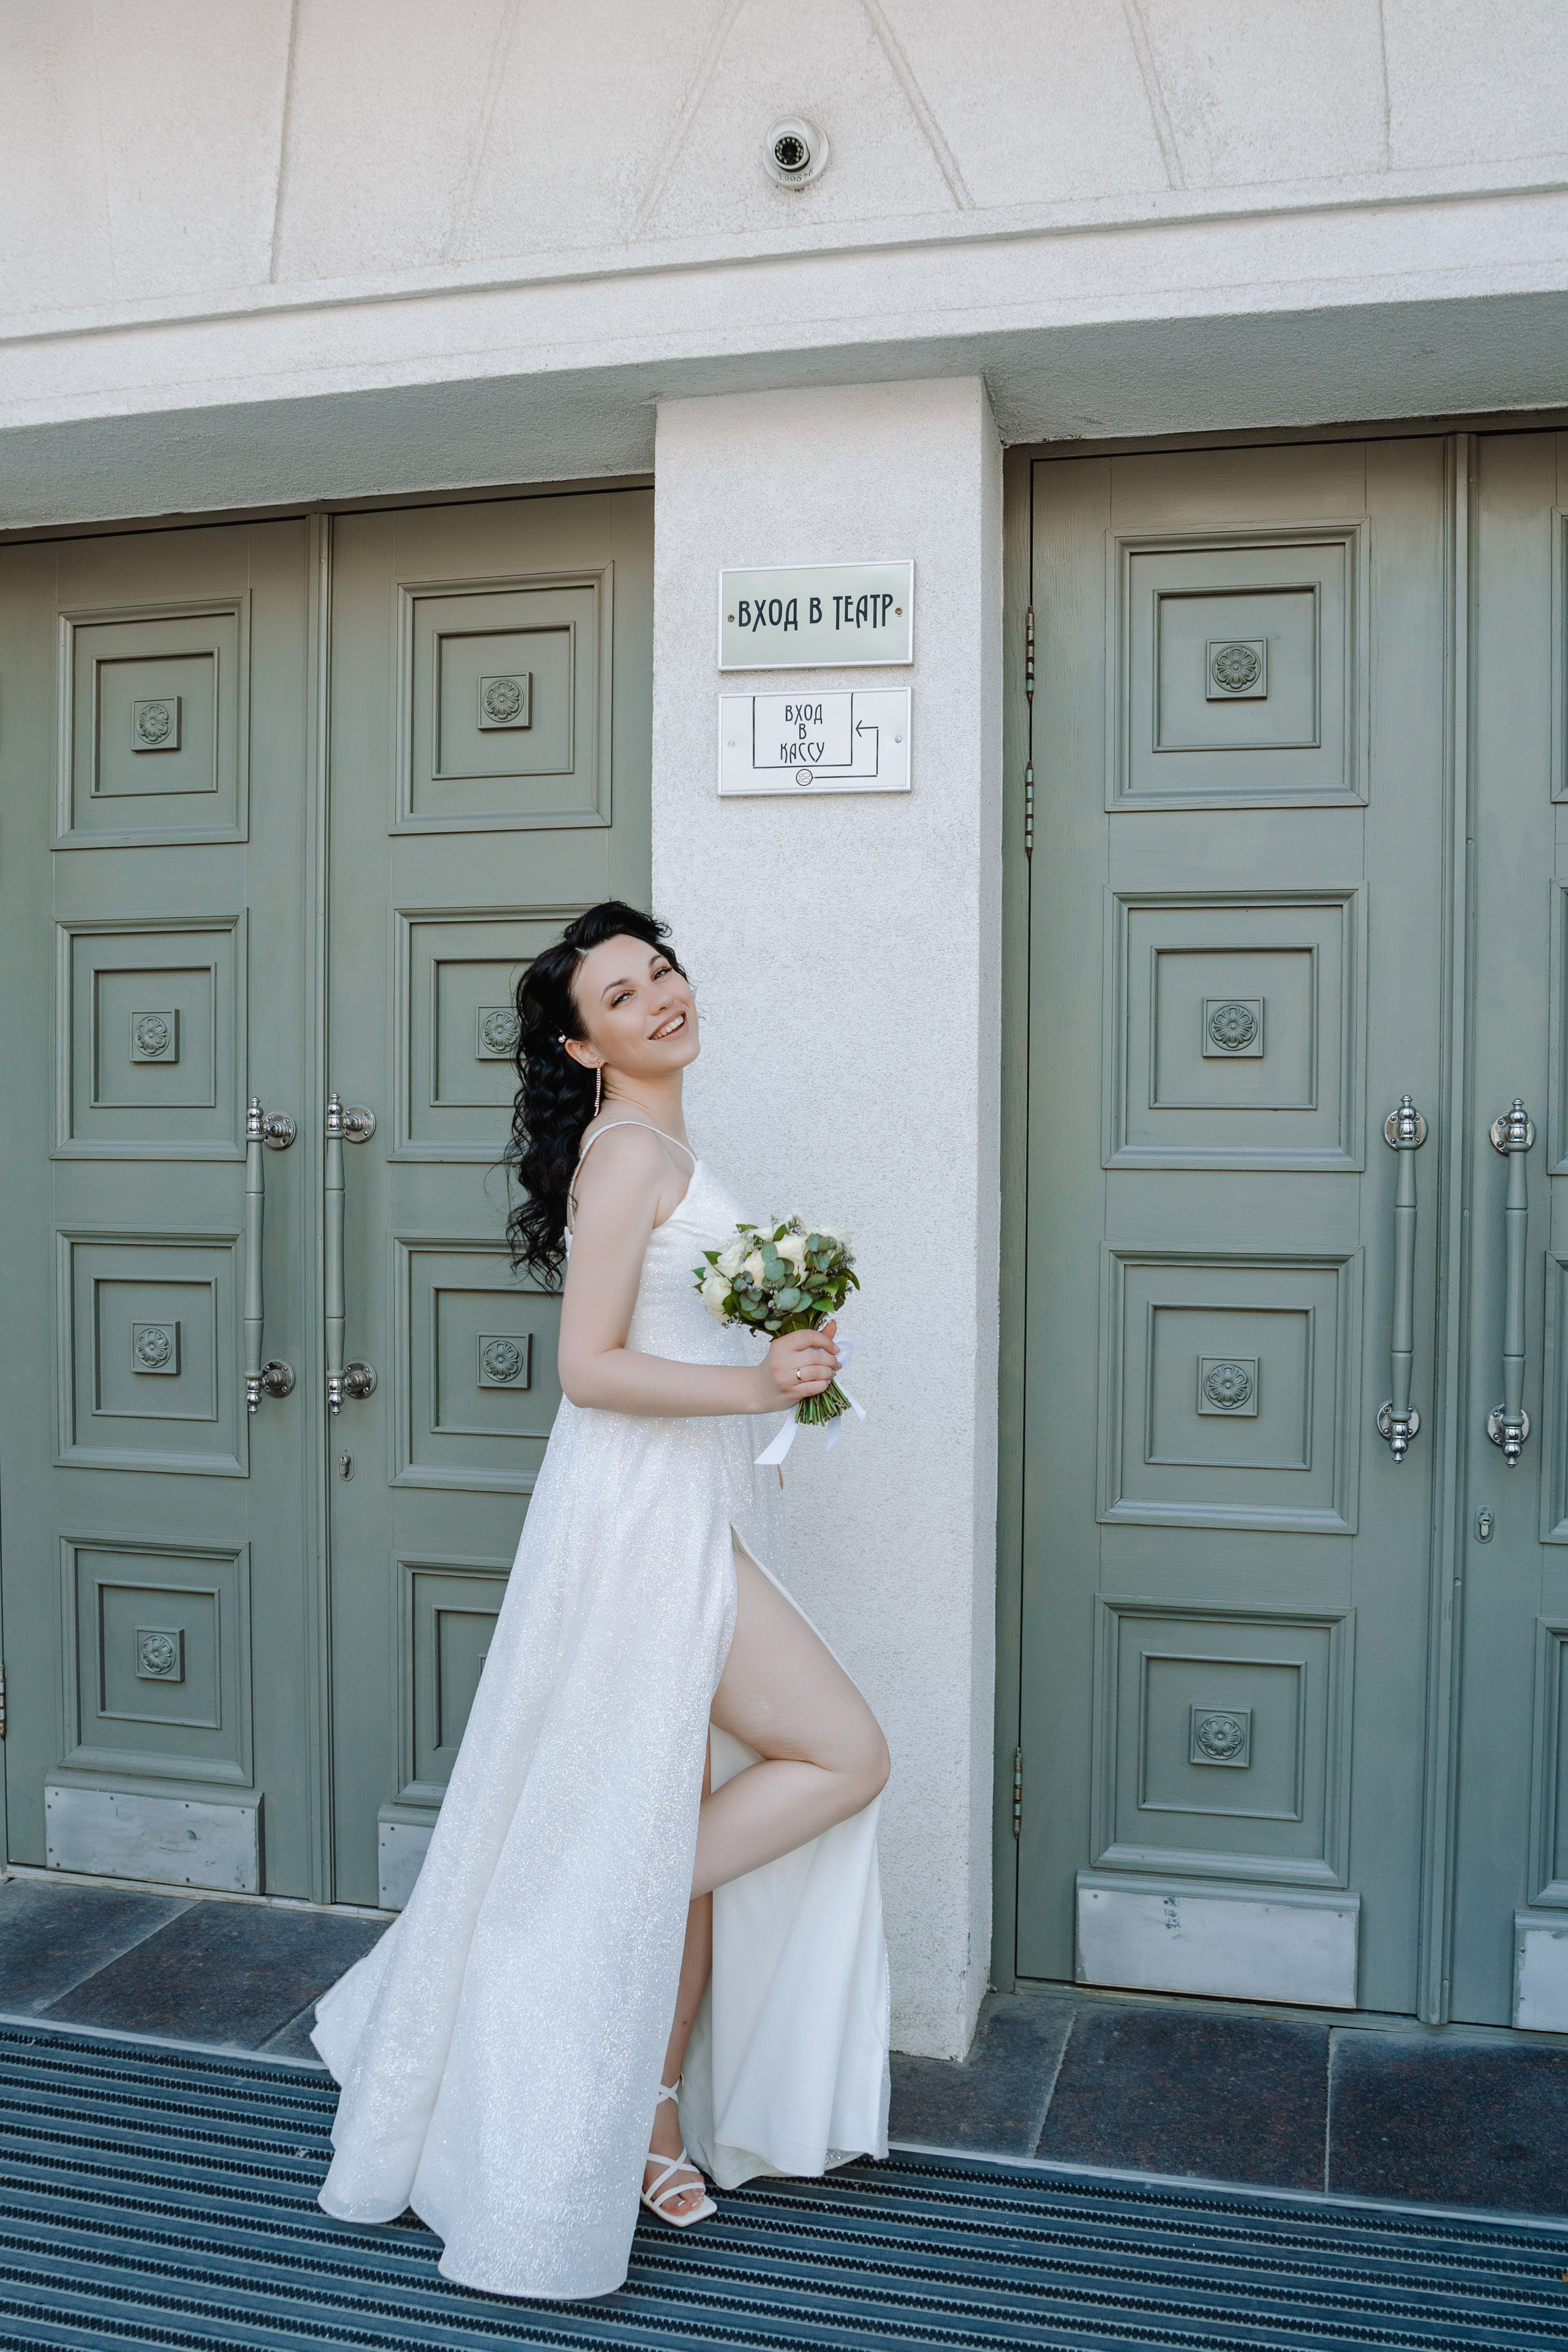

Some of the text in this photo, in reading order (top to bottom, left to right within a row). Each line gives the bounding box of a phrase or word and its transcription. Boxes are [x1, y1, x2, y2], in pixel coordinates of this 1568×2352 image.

[739, 594, 893, 632] ВХОД В ТЕАТР
[785, 704, 823, 725] ВХОД
[799, 723, 807, 740] В
[780, 742, 824, 763] КАССУ
